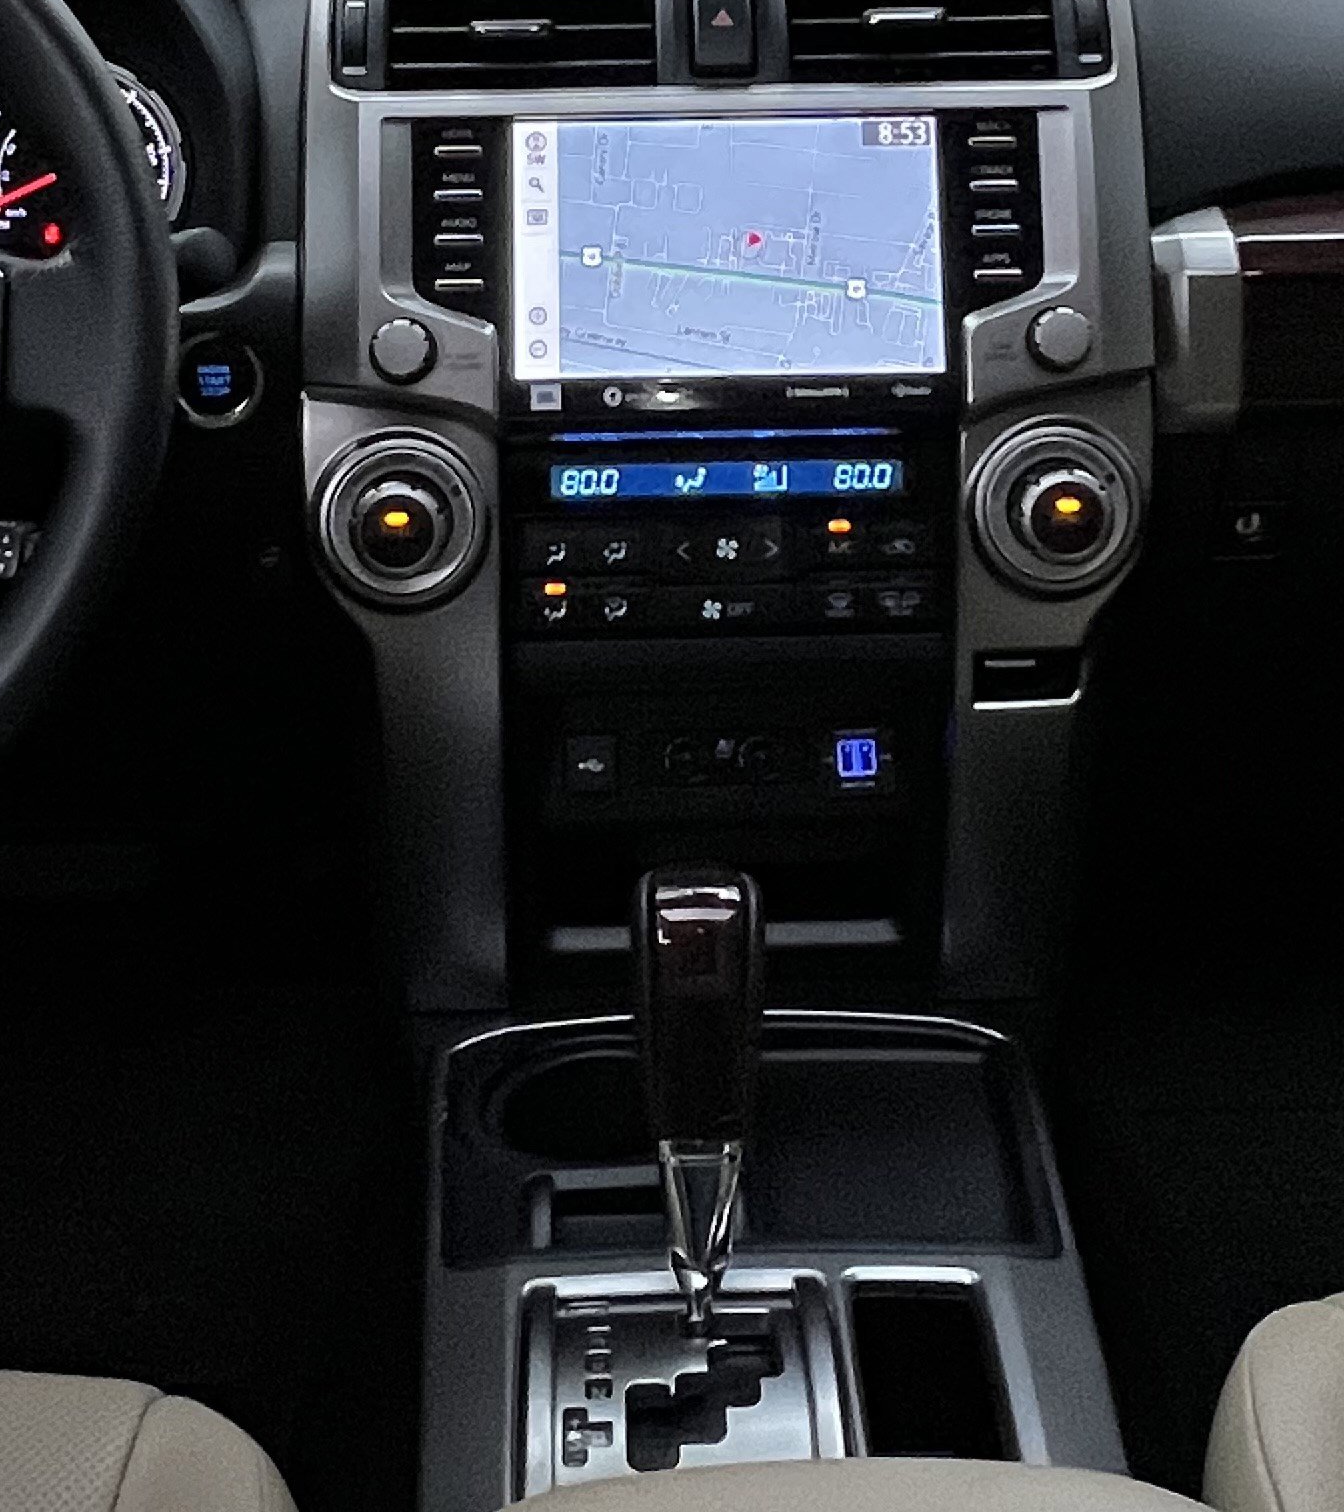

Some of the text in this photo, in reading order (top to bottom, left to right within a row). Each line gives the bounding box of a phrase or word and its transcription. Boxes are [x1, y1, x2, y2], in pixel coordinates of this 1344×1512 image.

[878, 122, 927, 145] 8:53
[560, 468, 621, 495] 80.0
[832, 462, 894, 490] 80.0
